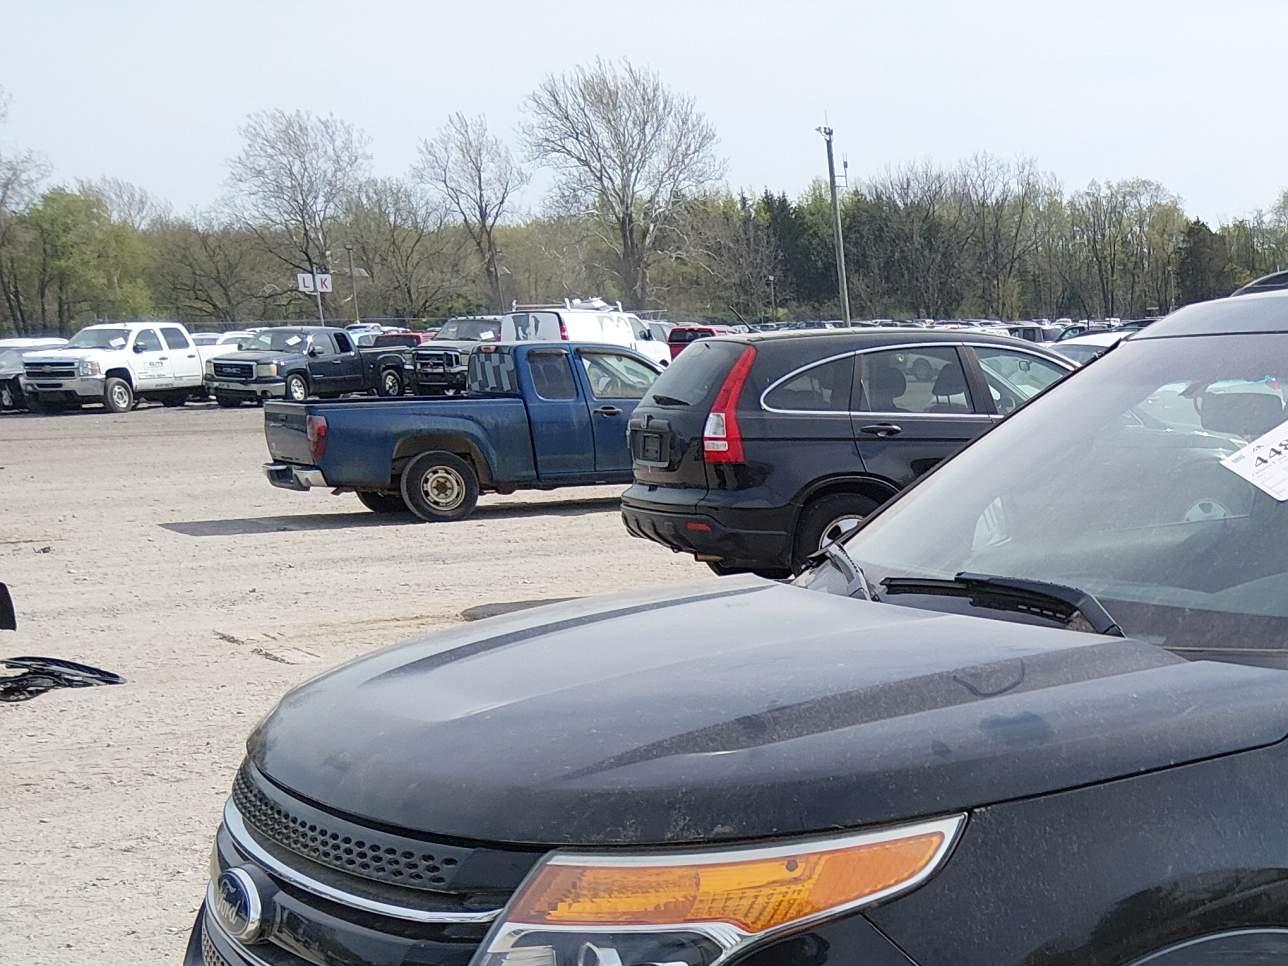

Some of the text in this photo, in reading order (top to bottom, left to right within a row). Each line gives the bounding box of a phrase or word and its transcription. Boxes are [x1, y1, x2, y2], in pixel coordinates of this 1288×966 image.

[302, 276, 311, 289] L
[320, 277, 329, 289] K
[214, 878, 246, 925] Ford
